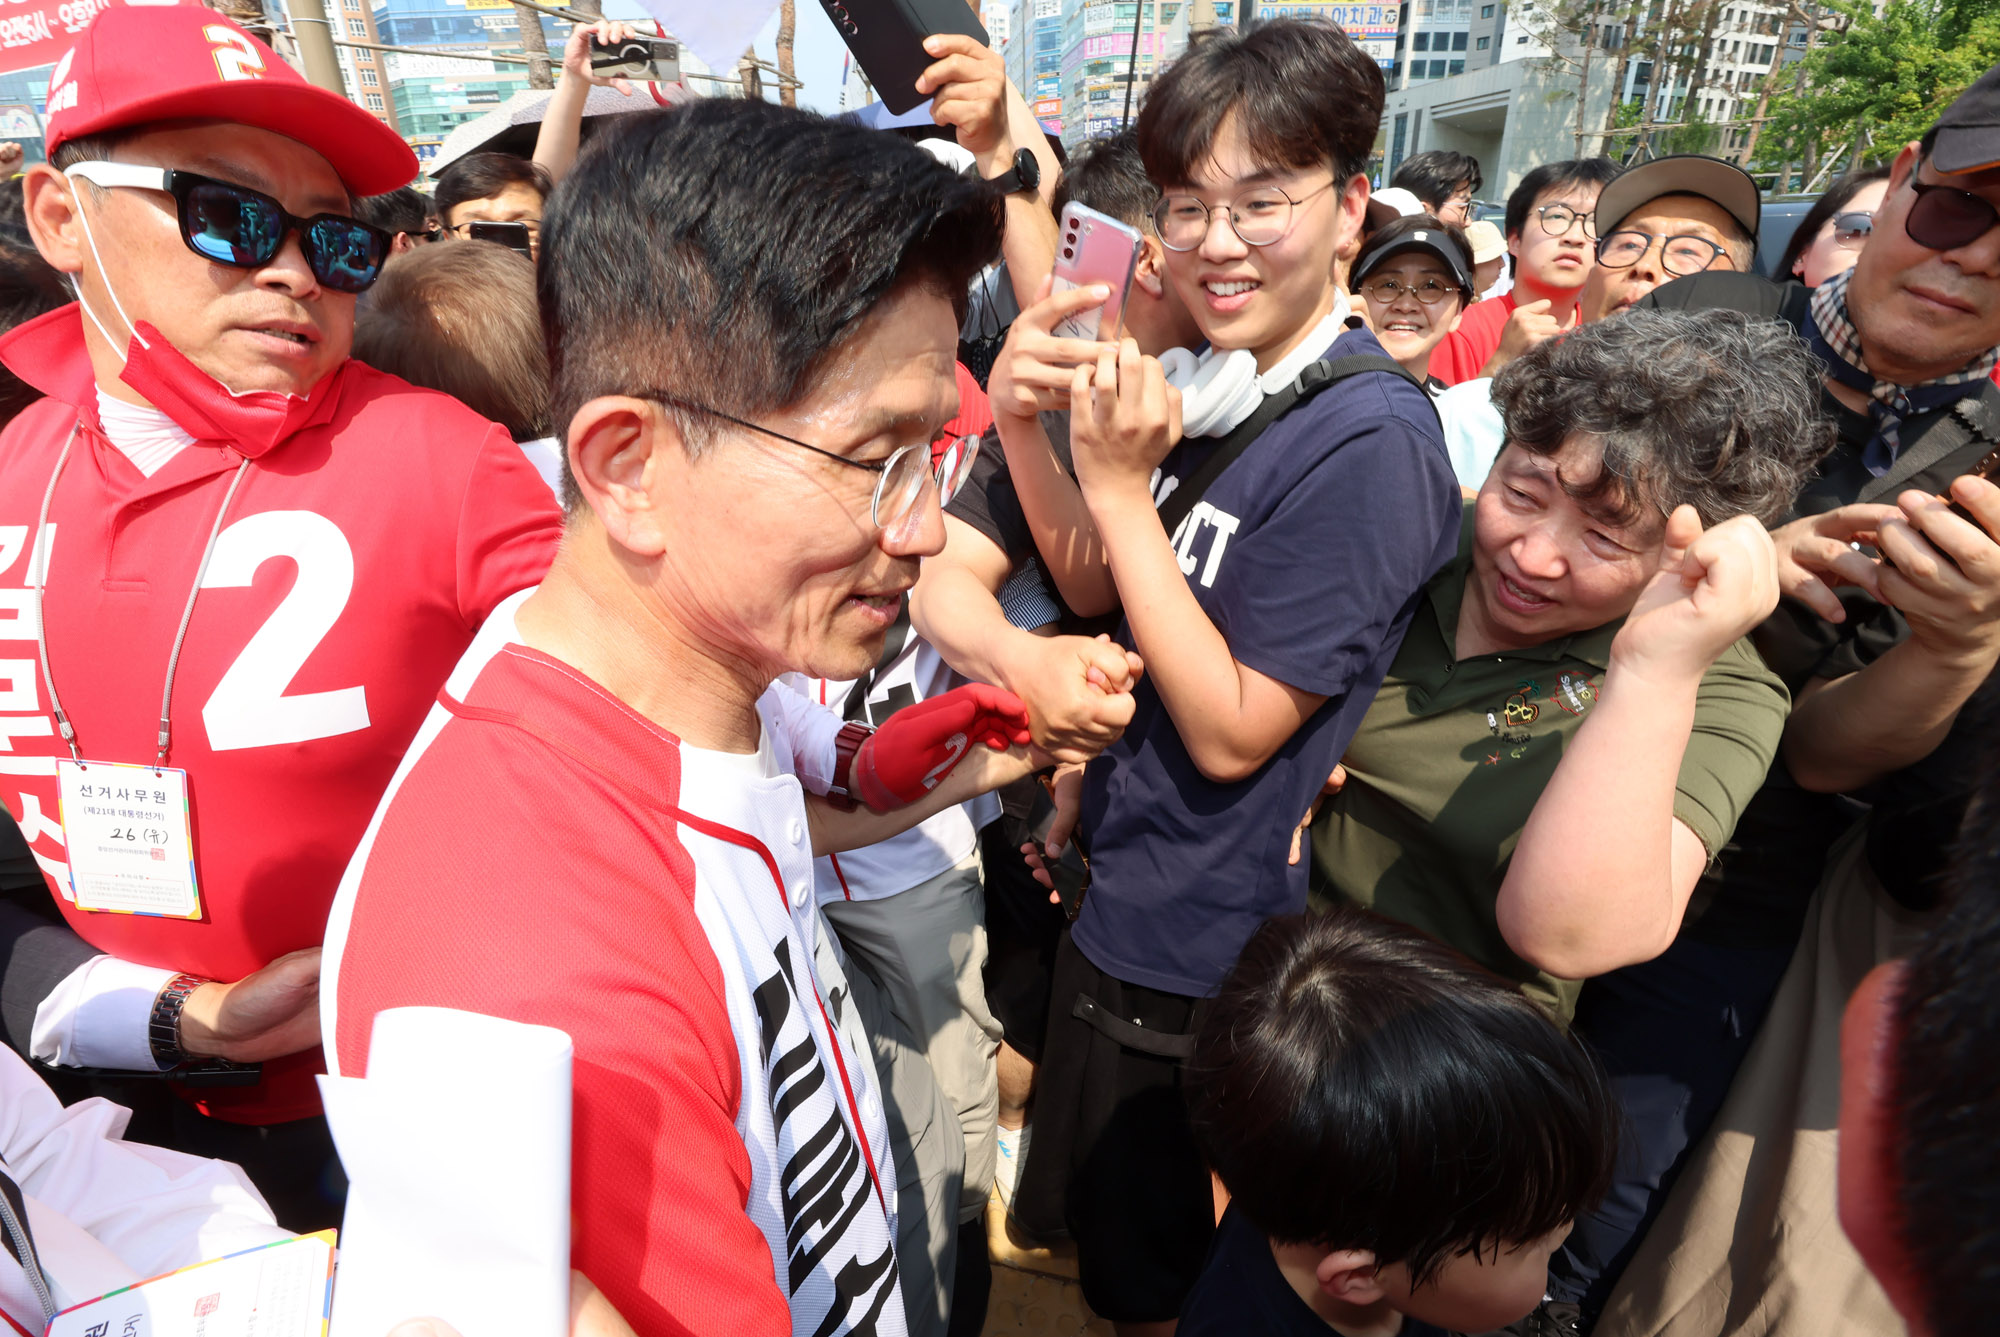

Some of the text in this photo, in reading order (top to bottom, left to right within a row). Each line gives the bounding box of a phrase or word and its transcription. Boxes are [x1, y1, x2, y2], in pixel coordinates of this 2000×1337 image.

[203, 23, 267, 82] 2
[1086, 36, 1114, 56] 내과
[200, 510, 371, 751] 2
[921, 731, 968, 790] 2
[80, 784, 166, 804] 선거사무원
[83, 806, 165, 821] (제21대 대통령선거)
[110, 828, 136, 841] 26
